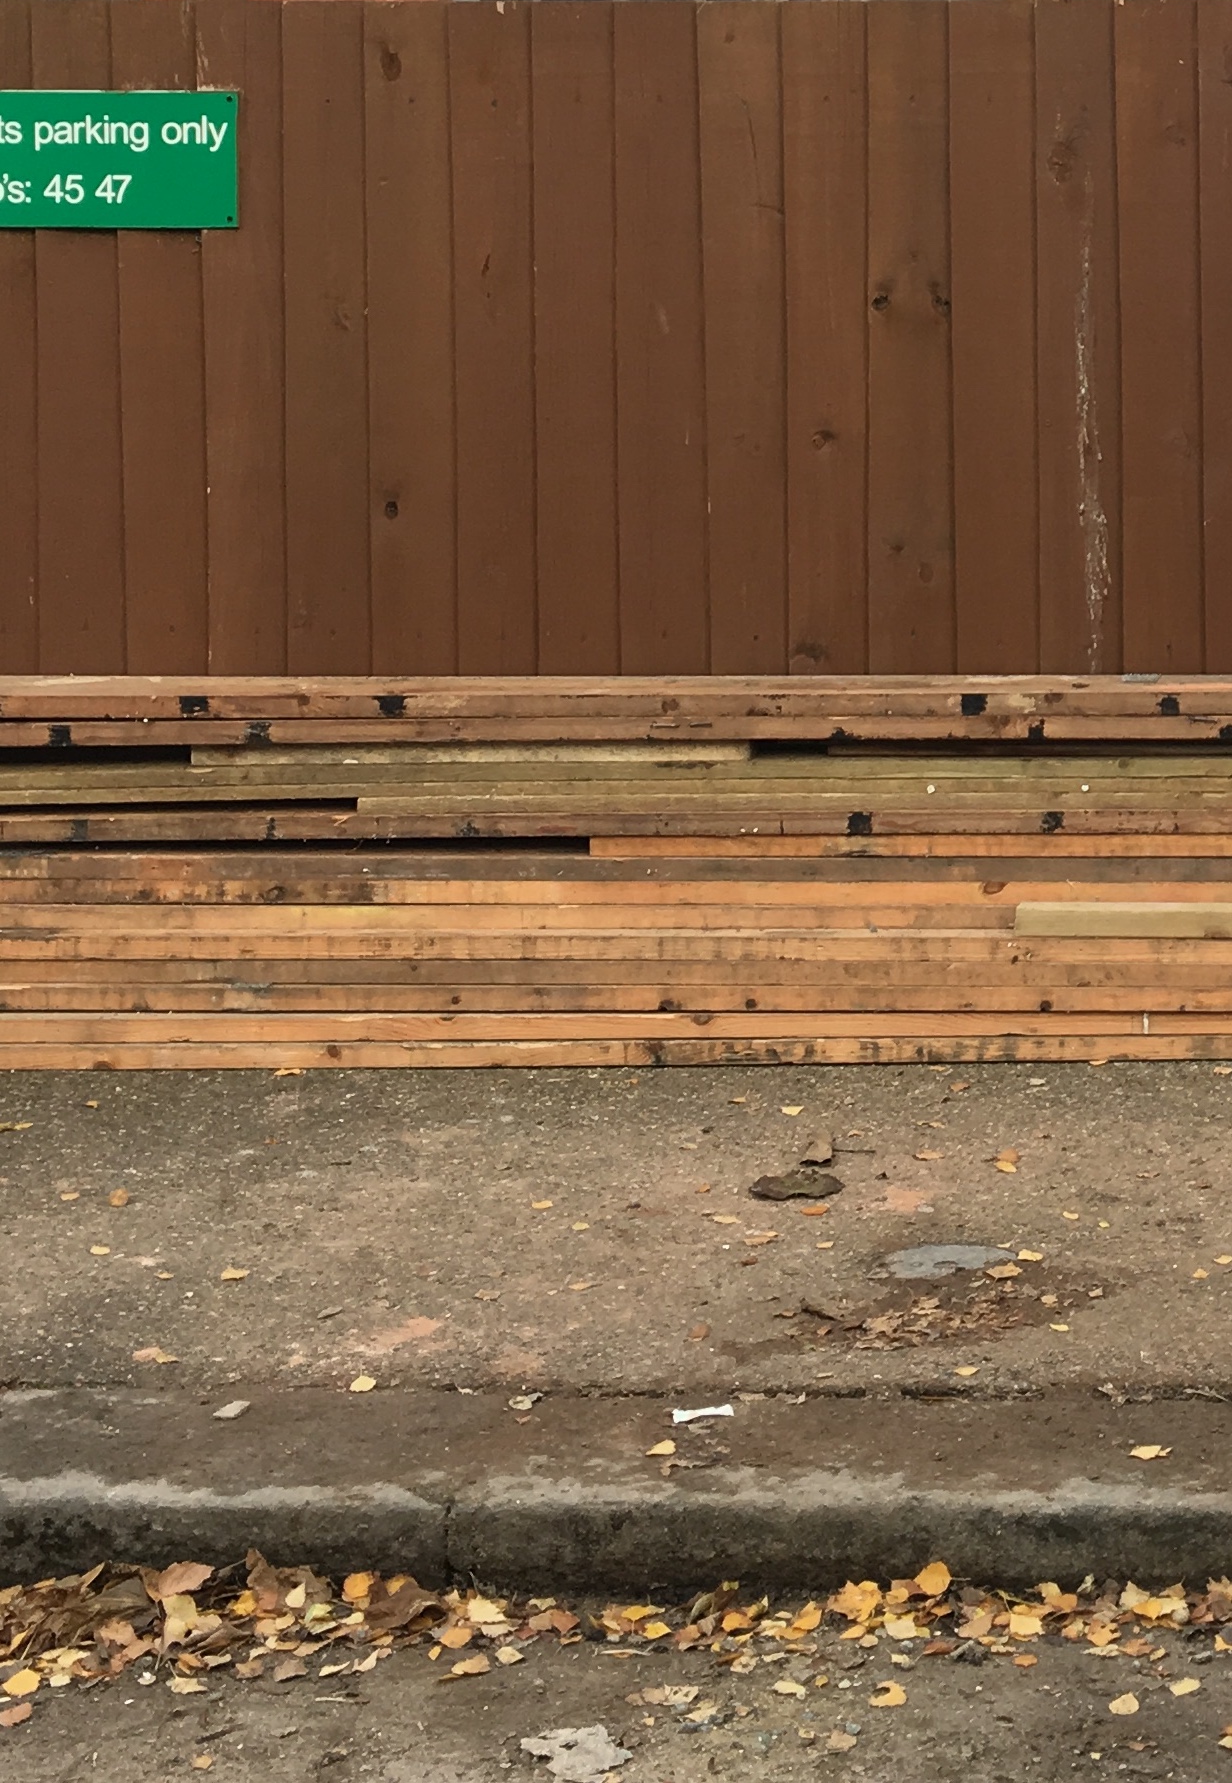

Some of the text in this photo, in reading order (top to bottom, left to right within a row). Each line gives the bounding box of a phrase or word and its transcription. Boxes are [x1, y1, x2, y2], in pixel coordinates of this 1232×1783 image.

[34, 114, 149, 152] parking
[161, 114, 228, 152] only
[0, 173, 133, 204] 's: 45 47
